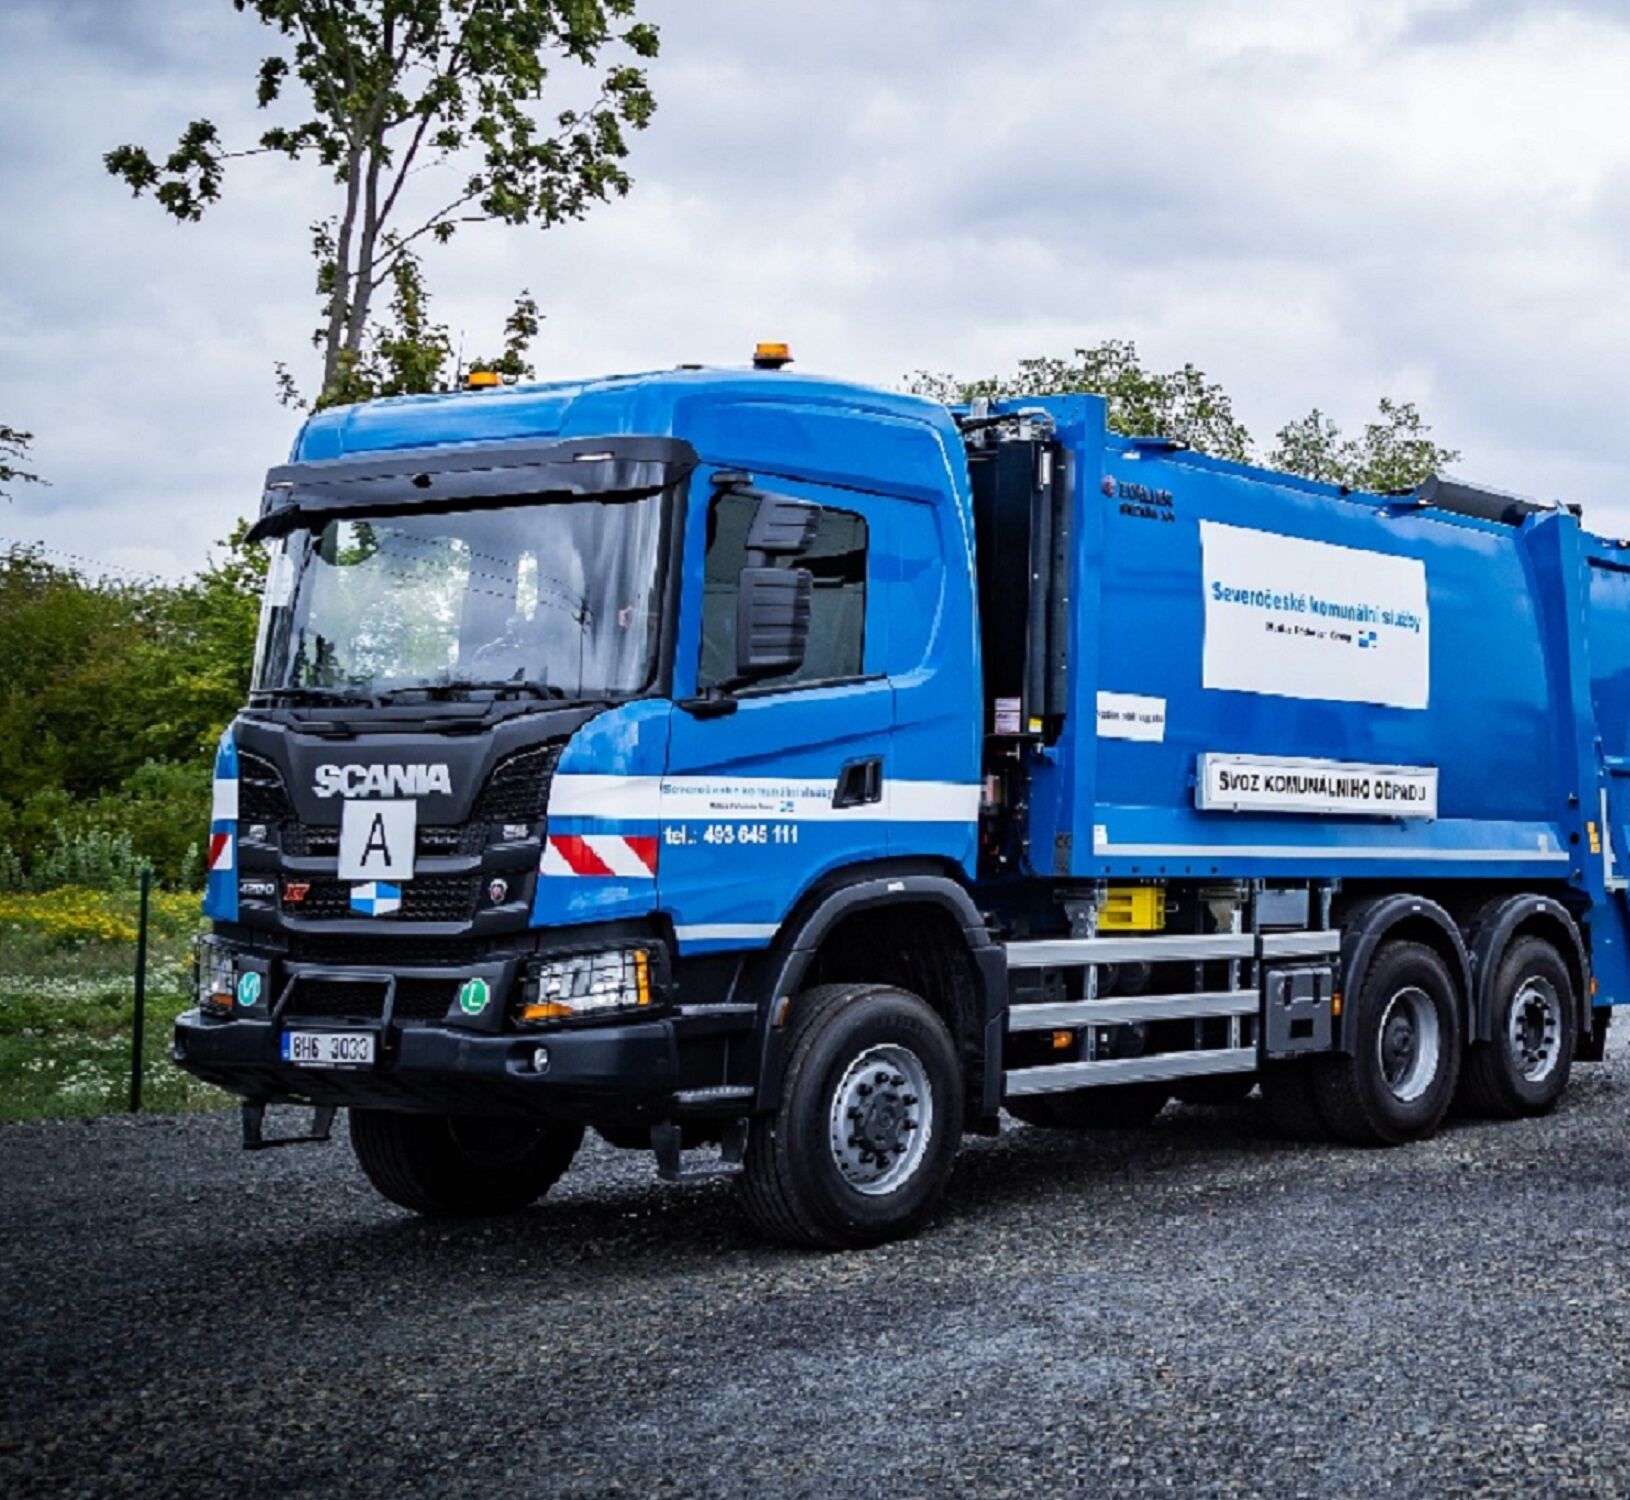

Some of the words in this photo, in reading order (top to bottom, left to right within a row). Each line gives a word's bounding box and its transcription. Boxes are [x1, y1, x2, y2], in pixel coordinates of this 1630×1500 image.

[311, 764, 453, 798] SCANIA
[1218, 771, 1260, 793] SVOZ
[1374, 780, 1426, 801] ODPADU
[359, 812, 392, 867] A
[663, 824, 698, 845] tel.:
[703, 824, 735, 844] 493
[737, 824, 768, 844] 645
[772, 824, 799, 844] 111
[468, 985, 482, 1007] L
[330, 1037, 369, 1060] 3033
